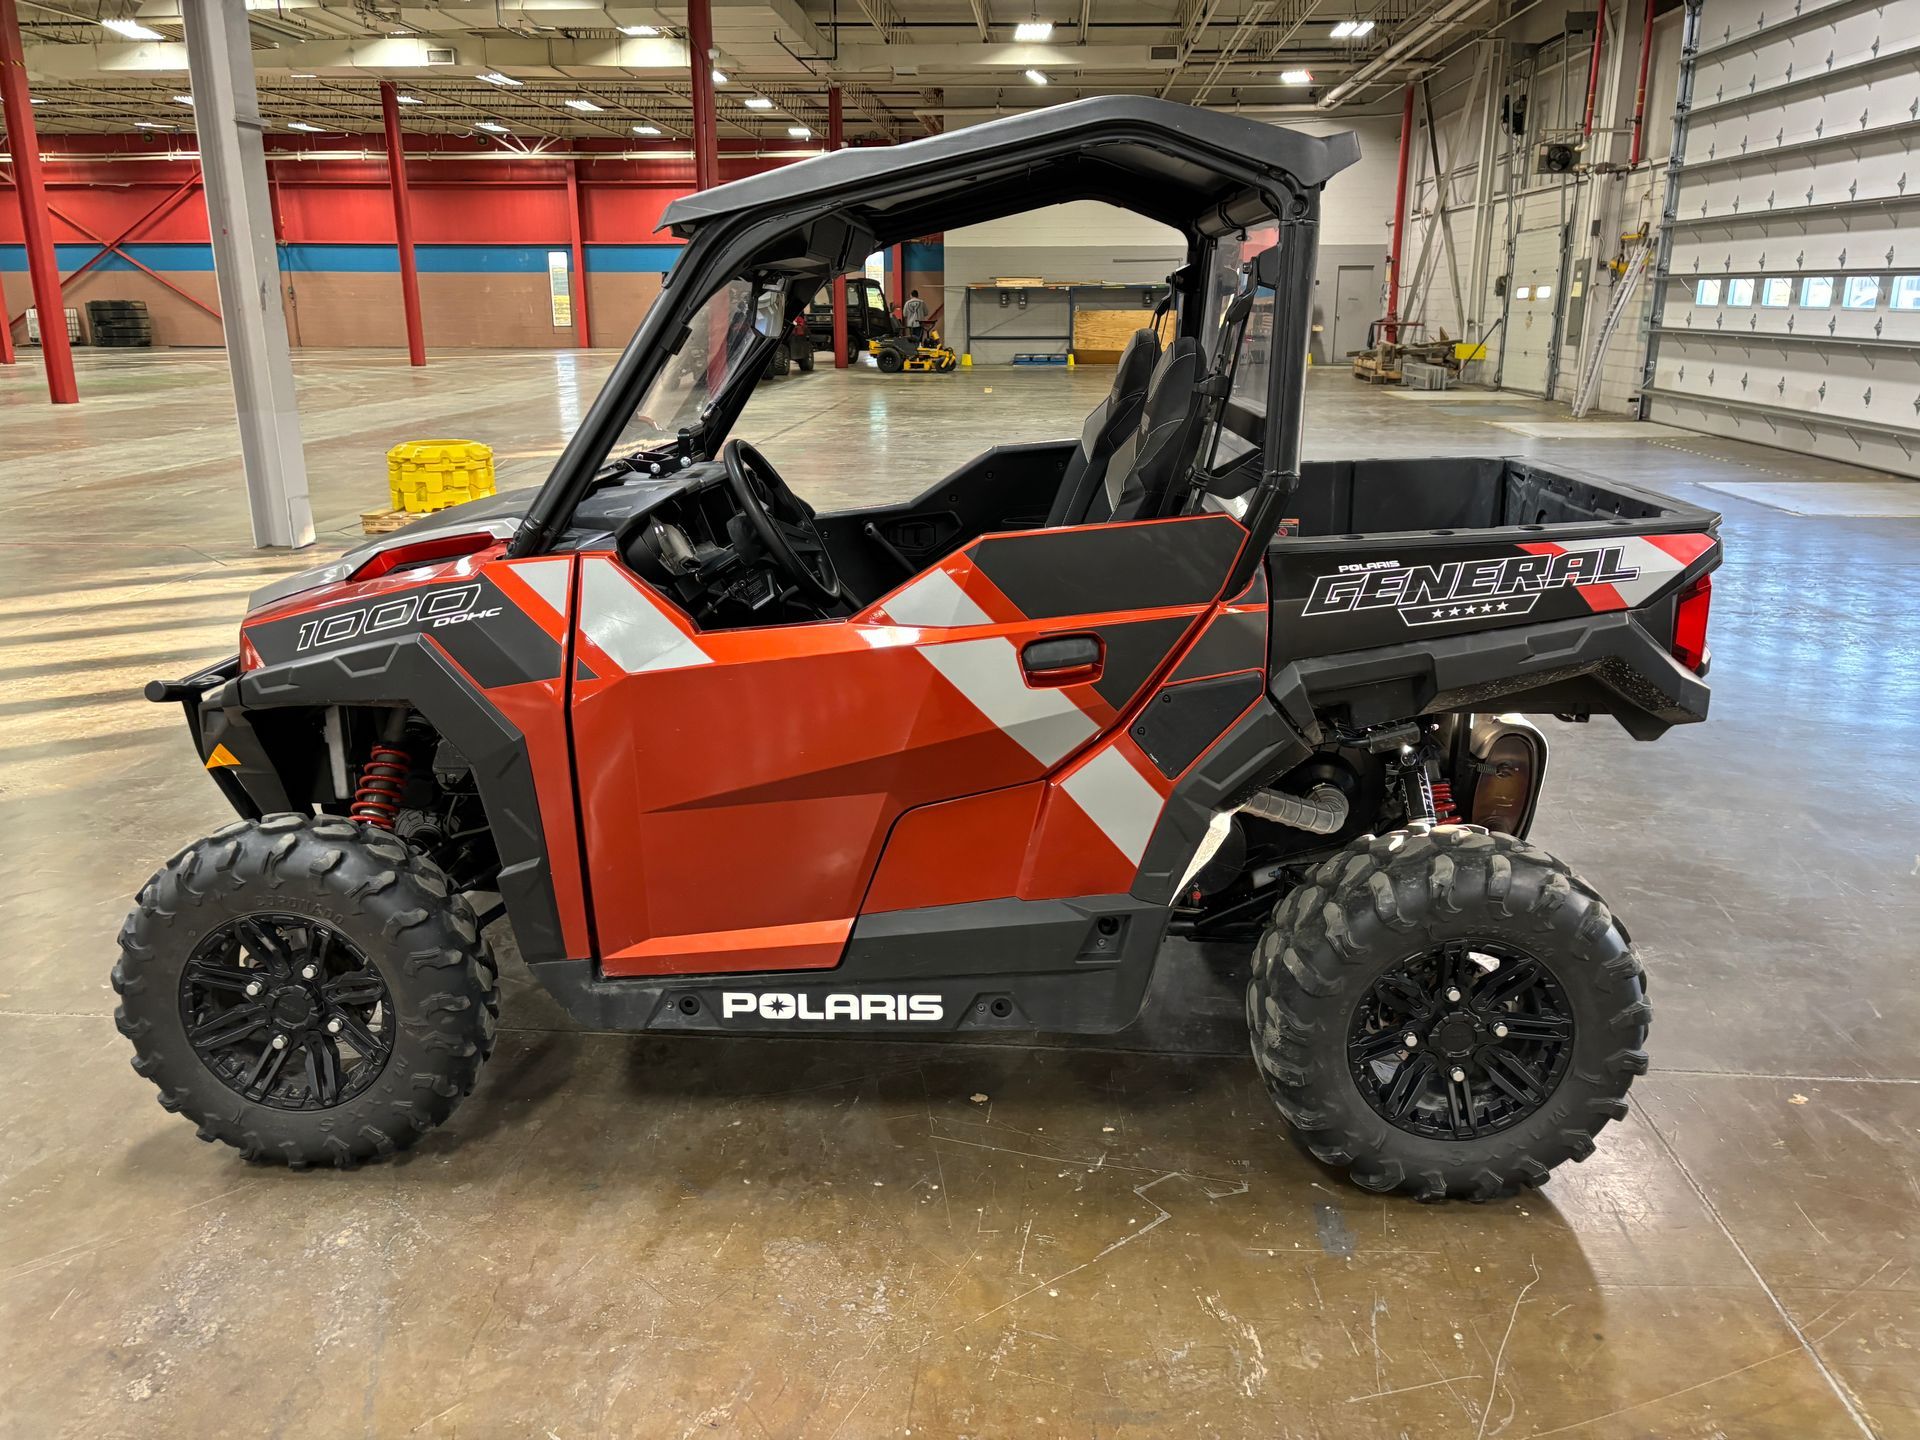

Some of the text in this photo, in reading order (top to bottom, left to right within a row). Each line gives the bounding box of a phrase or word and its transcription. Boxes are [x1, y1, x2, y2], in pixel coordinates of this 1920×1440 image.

[1301, 545, 1640, 617] GENERAL
[1338, 560, 1400, 573] POLARIS
[296, 583, 482, 651] 1000
[433, 606, 503, 628] DOHC
[722, 992, 944, 1021] POLARIS
